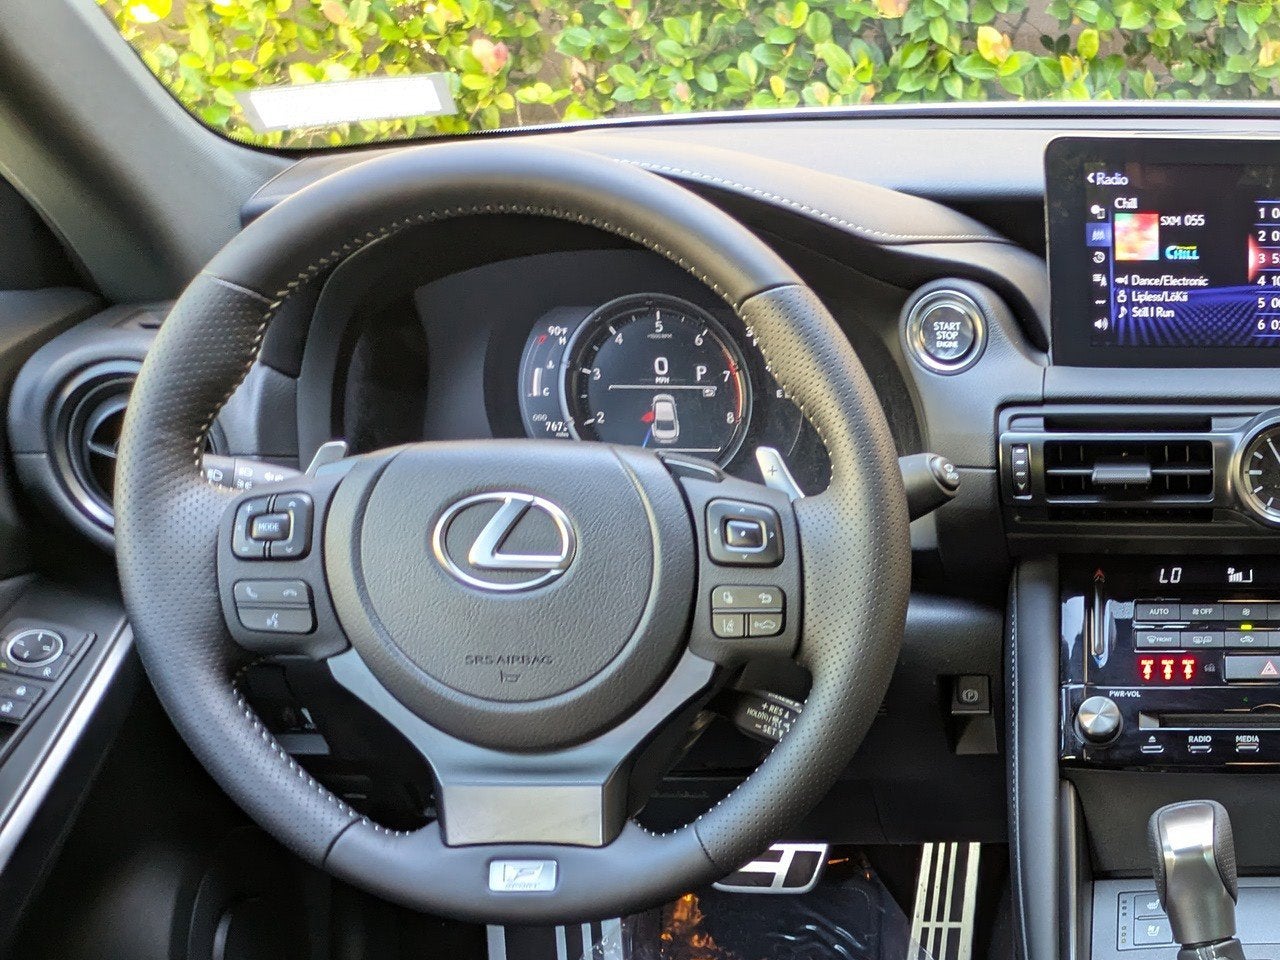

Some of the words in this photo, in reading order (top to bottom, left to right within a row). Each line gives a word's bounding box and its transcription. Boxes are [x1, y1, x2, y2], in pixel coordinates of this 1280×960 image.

[1096, 172, 1128, 186] Radio
[1114, 198, 1138, 209] Chill
[1259, 207, 1266, 218] 1
[1160, 215, 1181, 226] SXM
[1184, 215, 1205, 226] 055
[1258, 230, 1266, 241] 2
[1165, 245, 1199, 260] CHILL
[1258, 253, 1266, 264] 3
[1132, 275, 1209, 286] Dance/Electronic
[1258, 275, 1266, 286] 4
[1258, 297, 1266, 308] 5
[1132, 306, 1149, 318] Still
[1156, 307, 1175, 318] Run
[655, 321, 663, 333] 5
[934, 322, 961, 331] START
[1258, 319, 1266, 330] 6
[615, 333, 623, 345] 4
[695, 334, 703, 346] 6
[936, 331, 958, 340] STOP
[936, 340, 958, 348] ENGINE
[592, 368, 601, 380] 3
[696, 365, 707, 381] P
[723, 370, 731, 382] 7
[655, 376, 670, 384] MPH
[596, 411, 605, 424] 2
[726, 412, 735, 424] 8
[258, 522, 280, 532] MODE
[1159, 567, 1182, 584] LO
[464, 654, 494, 665] SRS
[496, 654, 553, 665] AIRBAG
[768, 704, 784, 716] RES
[763, 724, 777, 736] SET
